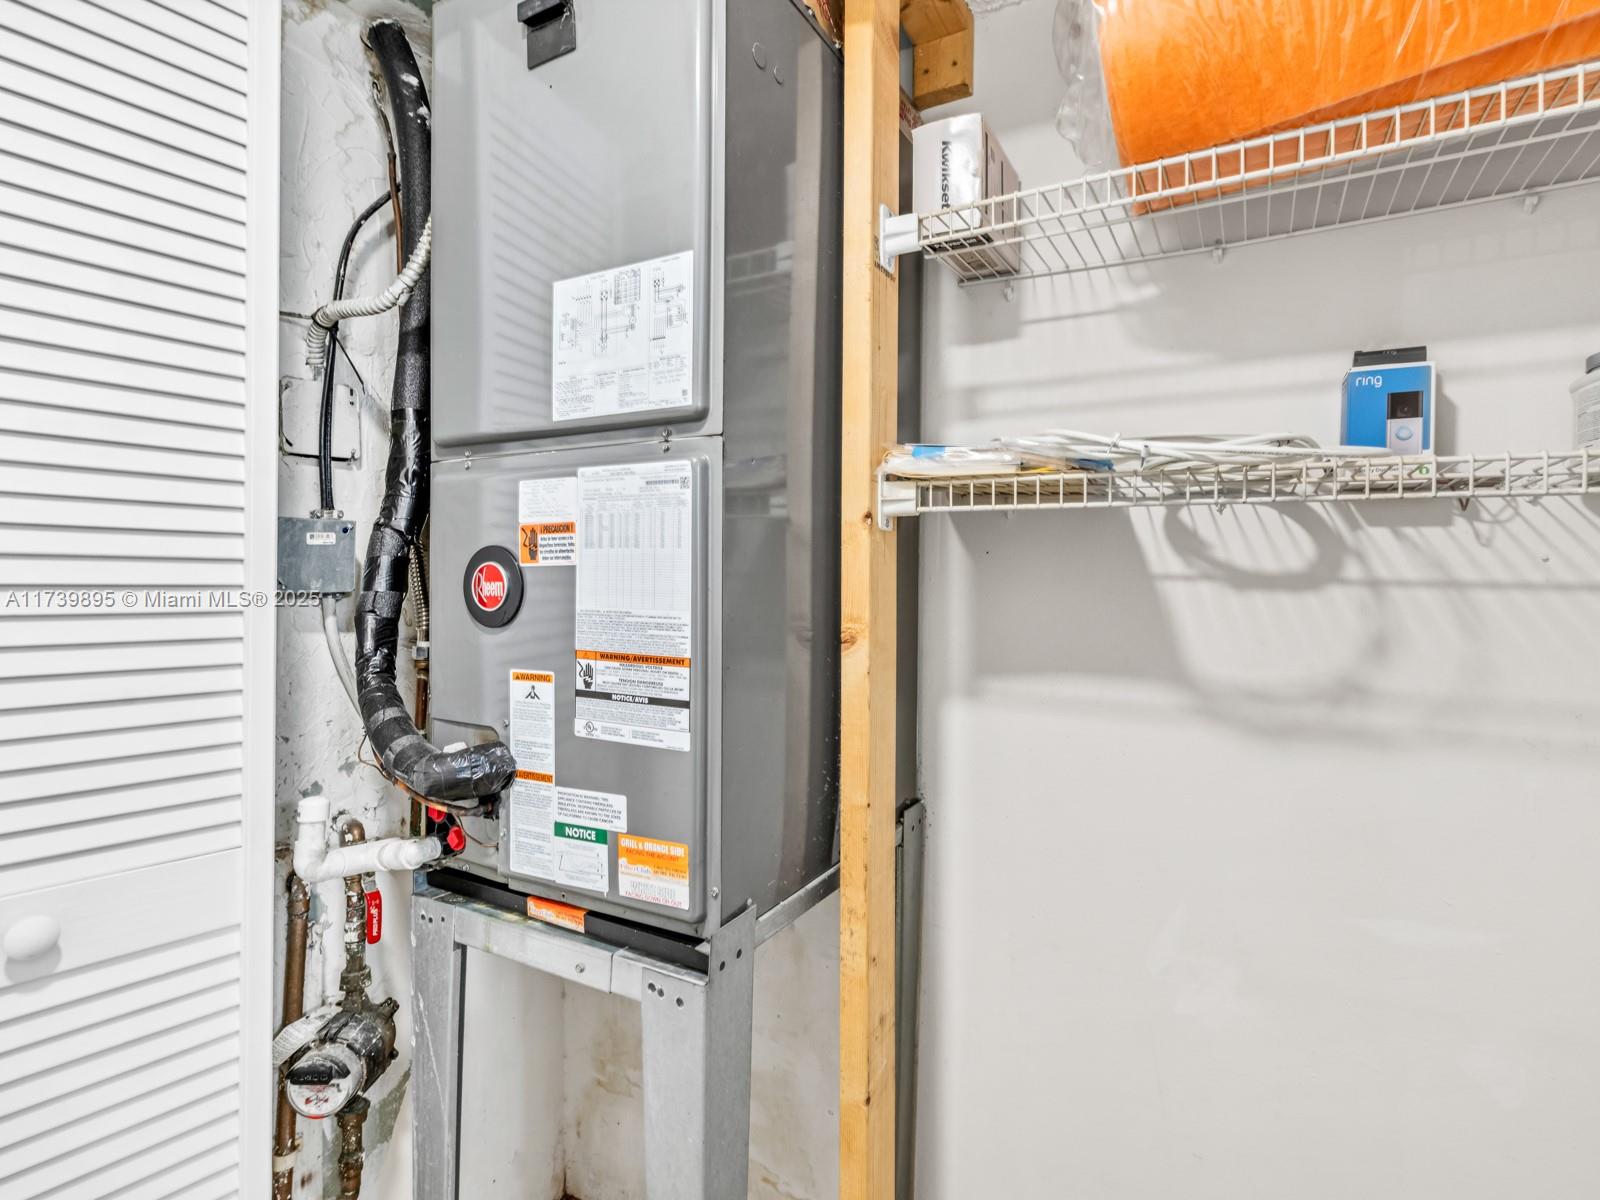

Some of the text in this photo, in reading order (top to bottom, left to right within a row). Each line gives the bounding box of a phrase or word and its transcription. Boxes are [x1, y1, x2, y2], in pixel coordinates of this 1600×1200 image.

[942, 140, 951, 210] Kwikset
[1356, 375, 1382, 388] ring
[520, 672, 551, 683] WARNING
[565, 826, 597, 841] NOTICE
